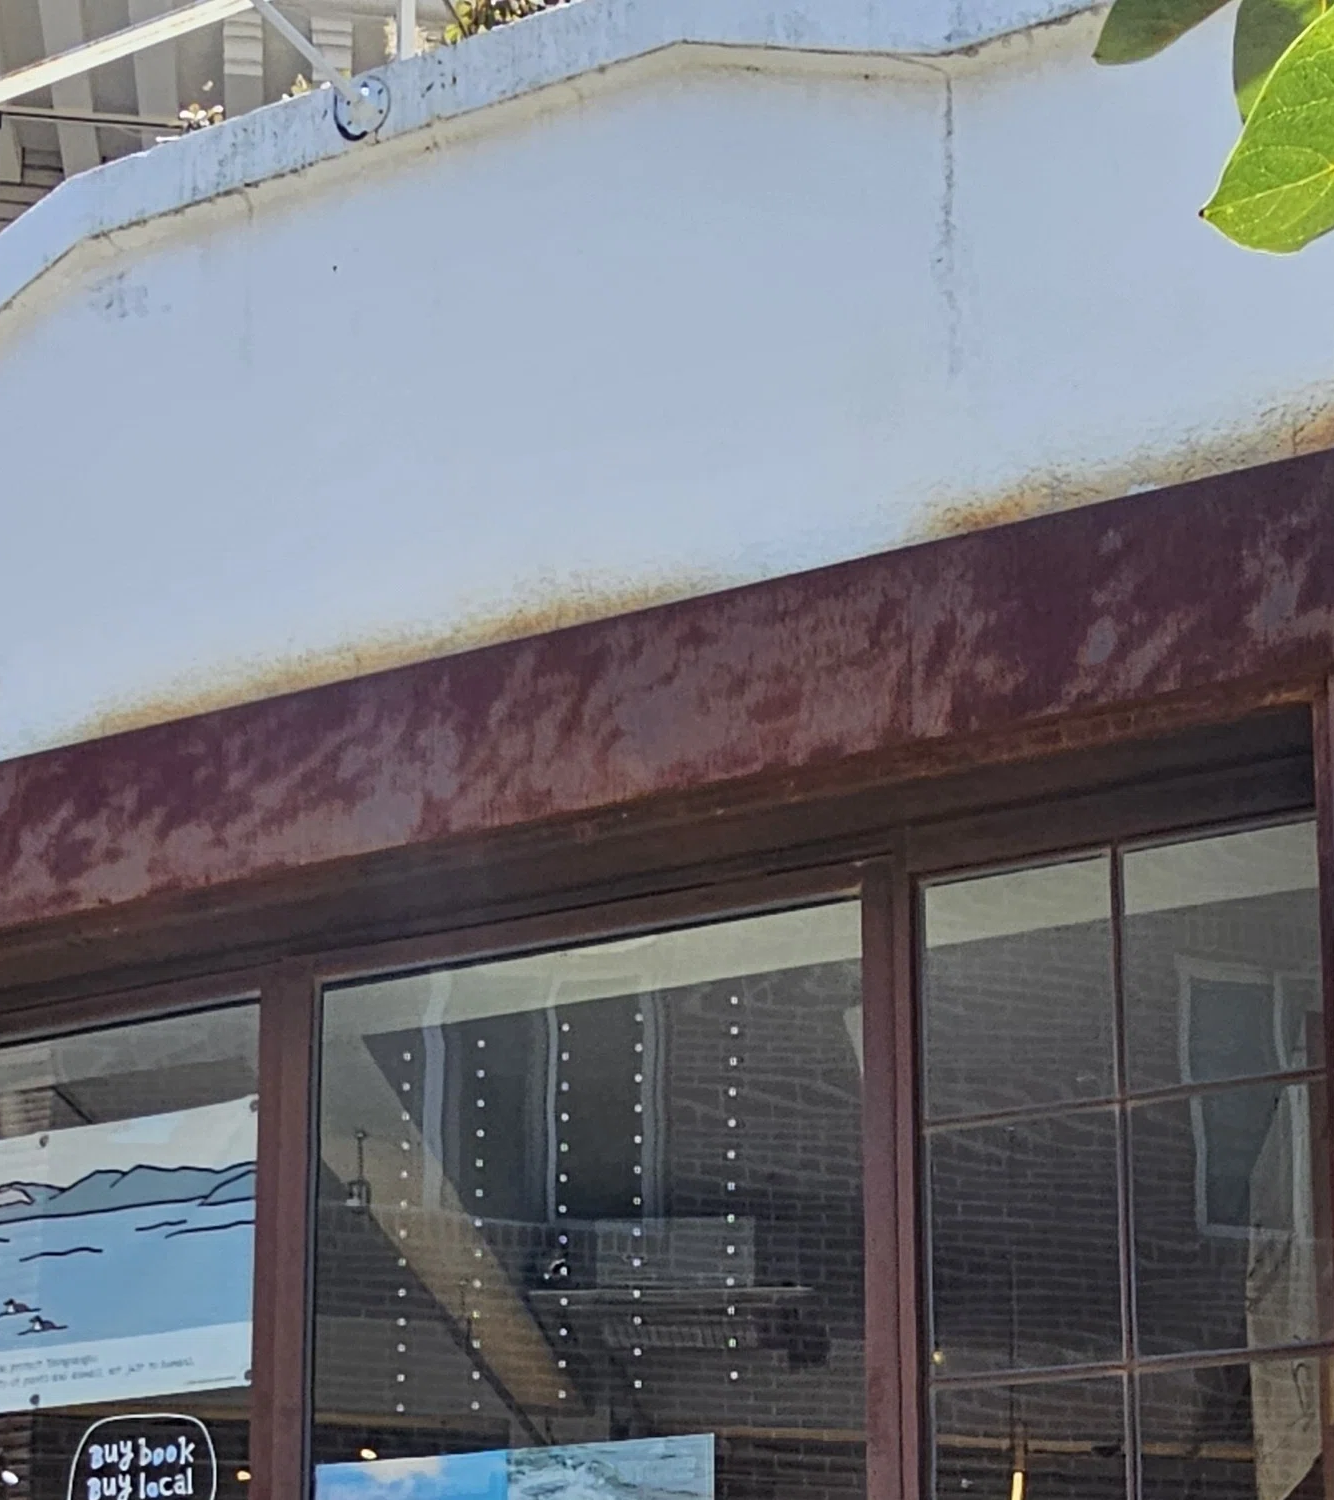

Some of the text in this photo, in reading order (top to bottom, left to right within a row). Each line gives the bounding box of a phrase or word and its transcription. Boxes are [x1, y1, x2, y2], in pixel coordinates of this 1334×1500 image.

[89, 1435, 195, 1471] Buy book
[139, 1467, 194, 1499] local
